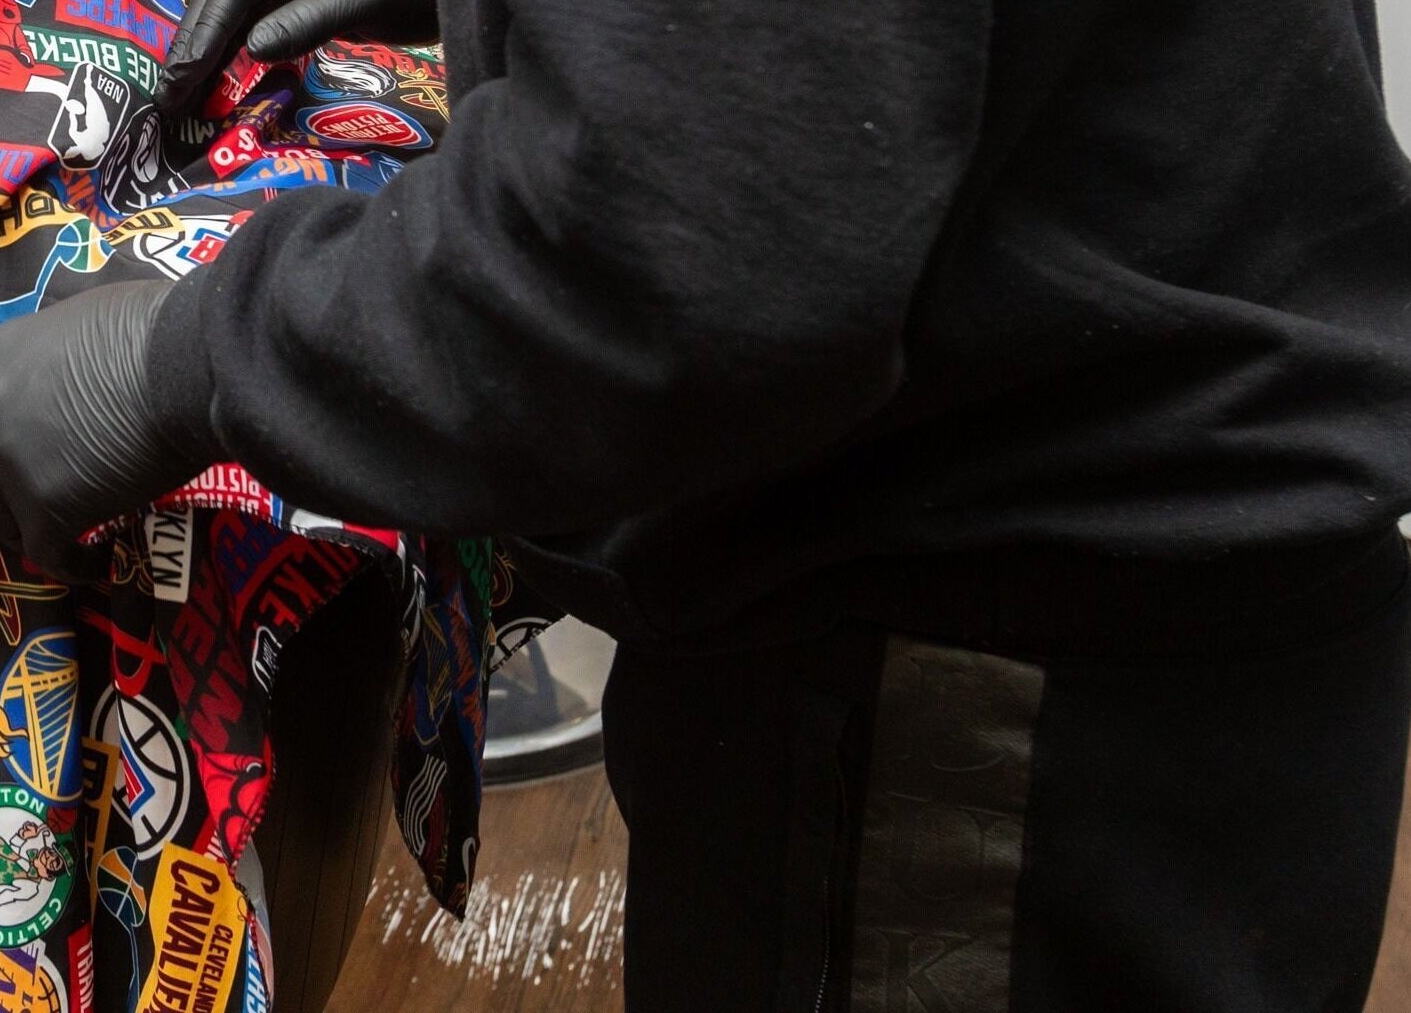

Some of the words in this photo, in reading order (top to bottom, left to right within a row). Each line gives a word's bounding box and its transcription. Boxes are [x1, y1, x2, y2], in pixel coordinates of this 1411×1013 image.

[97, 72, 125, 105] NBA
[323, 113, 388, 134] PISTONS
[338, 122, 403, 139] DETROIT
